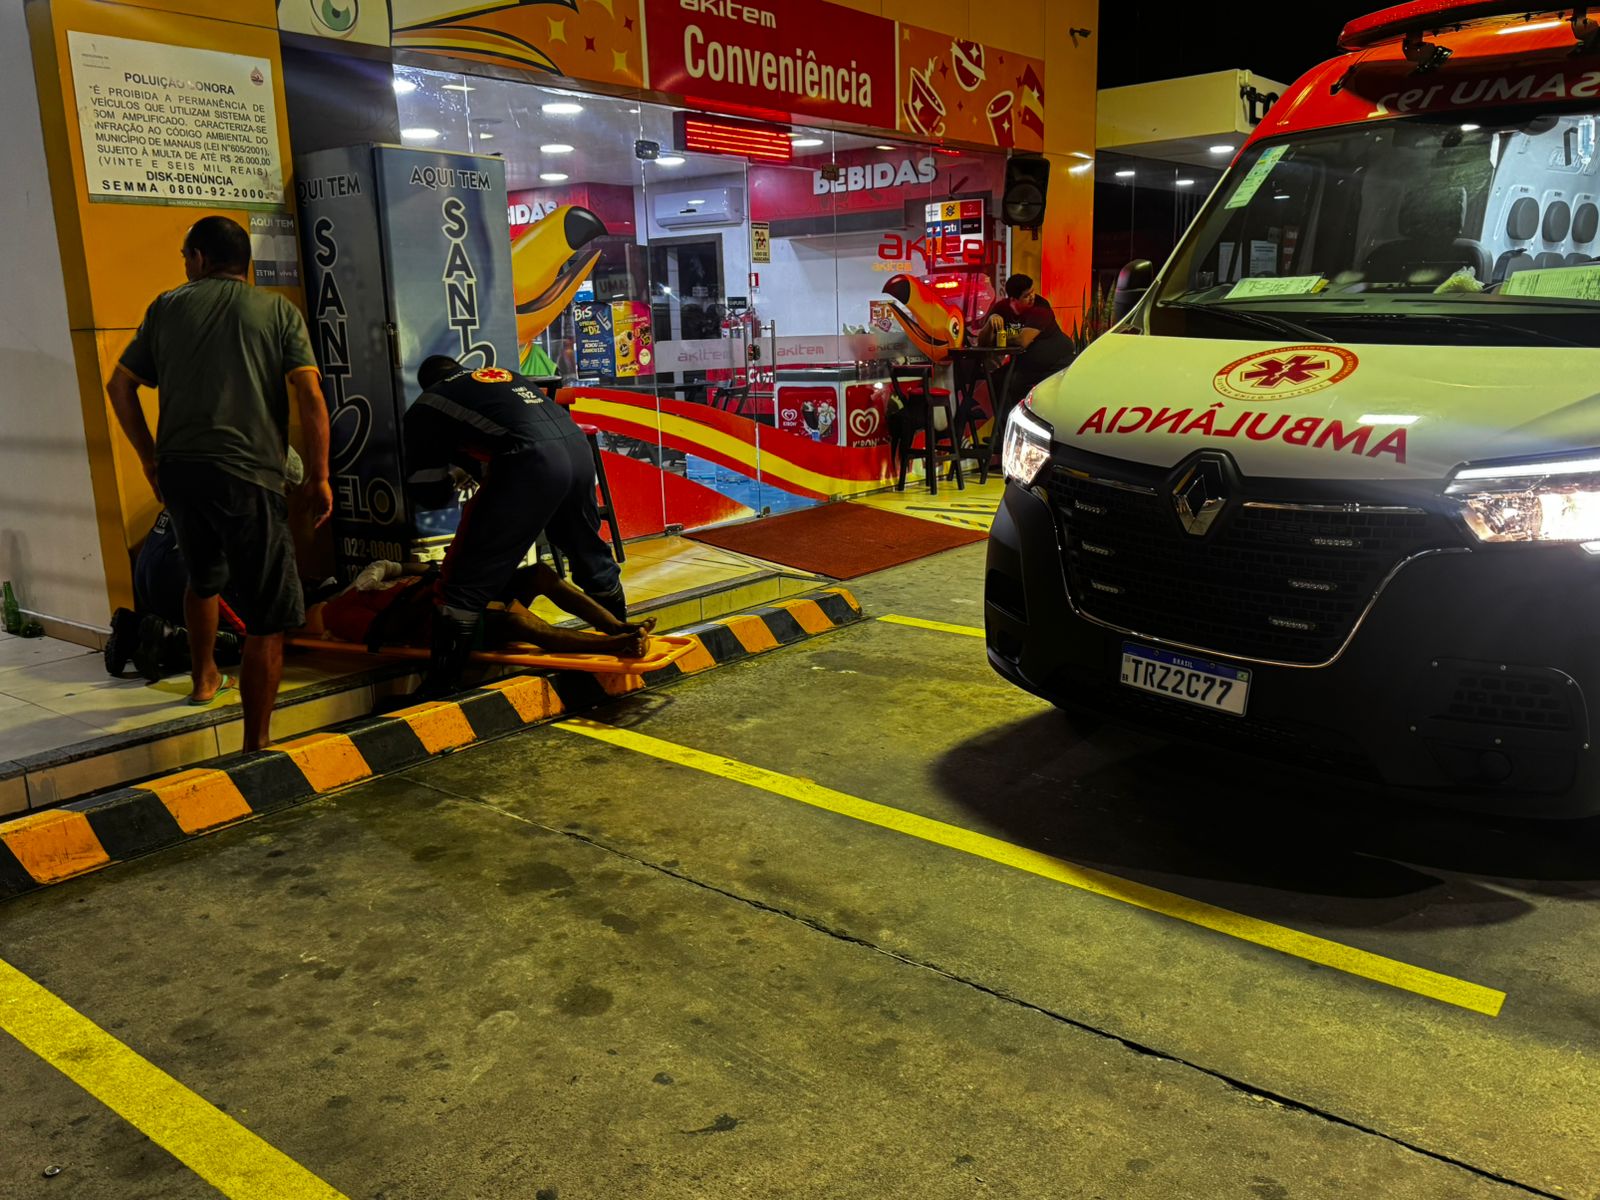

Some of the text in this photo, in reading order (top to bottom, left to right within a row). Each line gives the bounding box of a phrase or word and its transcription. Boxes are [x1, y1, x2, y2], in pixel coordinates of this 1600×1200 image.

[684, 24, 872, 108] Conveniência
[90, 96, 266, 124] VEÍCULOS QUE UTILIZAM SISTEMA DE
[108, 87, 159, 101] PROIBIDA
[164, 94, 172, 103] A
[178, 95, 247, 111] PERMANÊNCIA
[252, 104, 265, 113] DE
[93, 109, 116, 120] SOM
[194, 119, 267, 134] CARACTERIZA-SE
[94, 121, 269, 145] INFRAÇÃO AO CÓDIGO AMBIENTAL DO
[95, 132, 146, 145] MUNICÍPIO
[148, 137, 162, 146] DE
[163, 138, 202, 149] MANAUS
[203, 142, 220, 152] (LEI
[97, 144, 138, 156] SUJEITO
[152, 149, 182, 159] MULTA
[184, 151, 198, 160] DE
[200, 152, 217, 162] ATÉ
[220, 154, 232, 164] R$
[98, 156, 143, 168] (VINTE
[151, 160, 159, 169] E
[167, 161, 196, 171] SEIS
[203, 164, 223, 173] MIL
[102, 180, 159, 193] SEMMA
[146, 170, 234, 186] DISK-DENÚNCIA
[327, 174, 361, 196] TEM
[409, 166, 492, 191] AQUI TEM
[250, 217, 294, 228] AQUI TEM
[508, 201, 558, 225] IDAS
[777, 343, 824, 357] akitem
[338, 536, 403, 562] 022-0800
[1130, 658, 1233, 706] TRZ2C77
